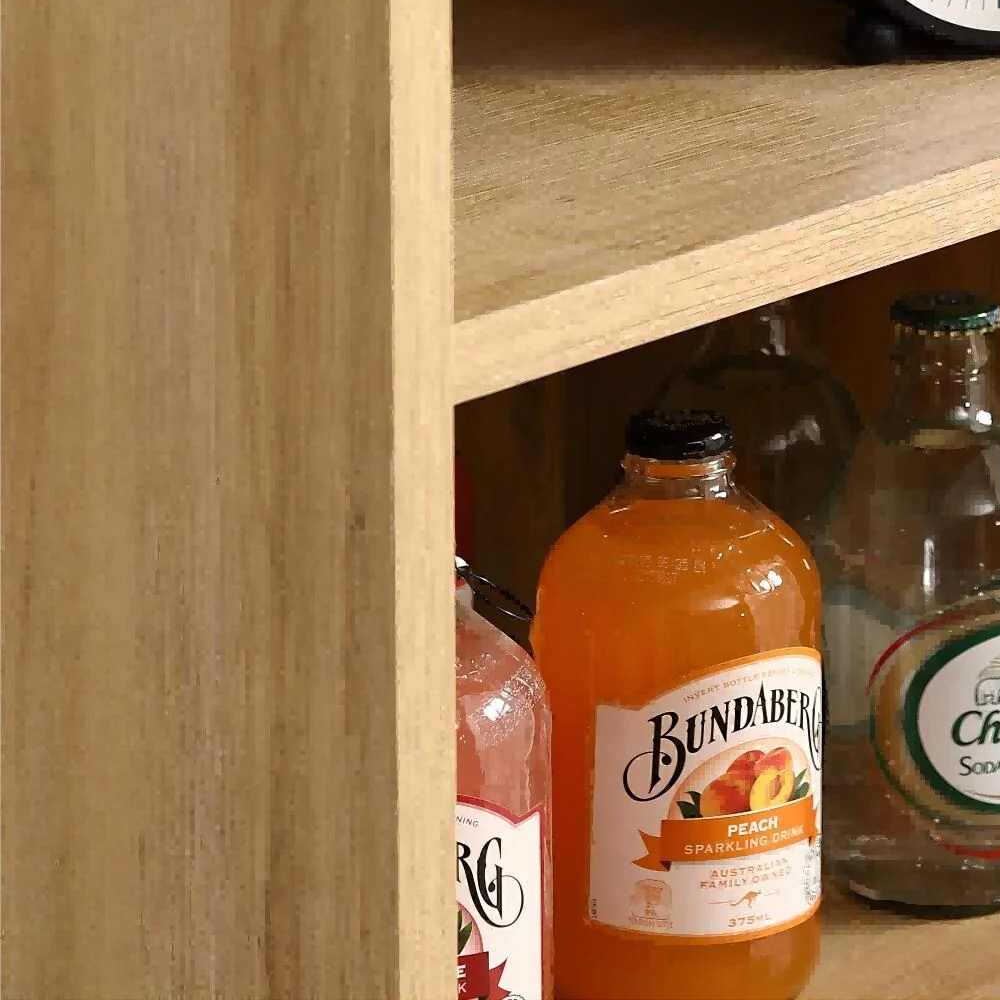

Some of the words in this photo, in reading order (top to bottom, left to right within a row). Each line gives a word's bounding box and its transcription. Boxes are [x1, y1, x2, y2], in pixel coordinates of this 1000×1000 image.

[683, 684, 720, 703] INVERT
[727, 815, 779, 838] PEACH
[684, 835, 768, 856] SPARKLING
[772, 825, 805, 842] DRINK
[711, 857, 789, 879] AUSTRALIAN
[700, 873, 748, 890] FAMILY
